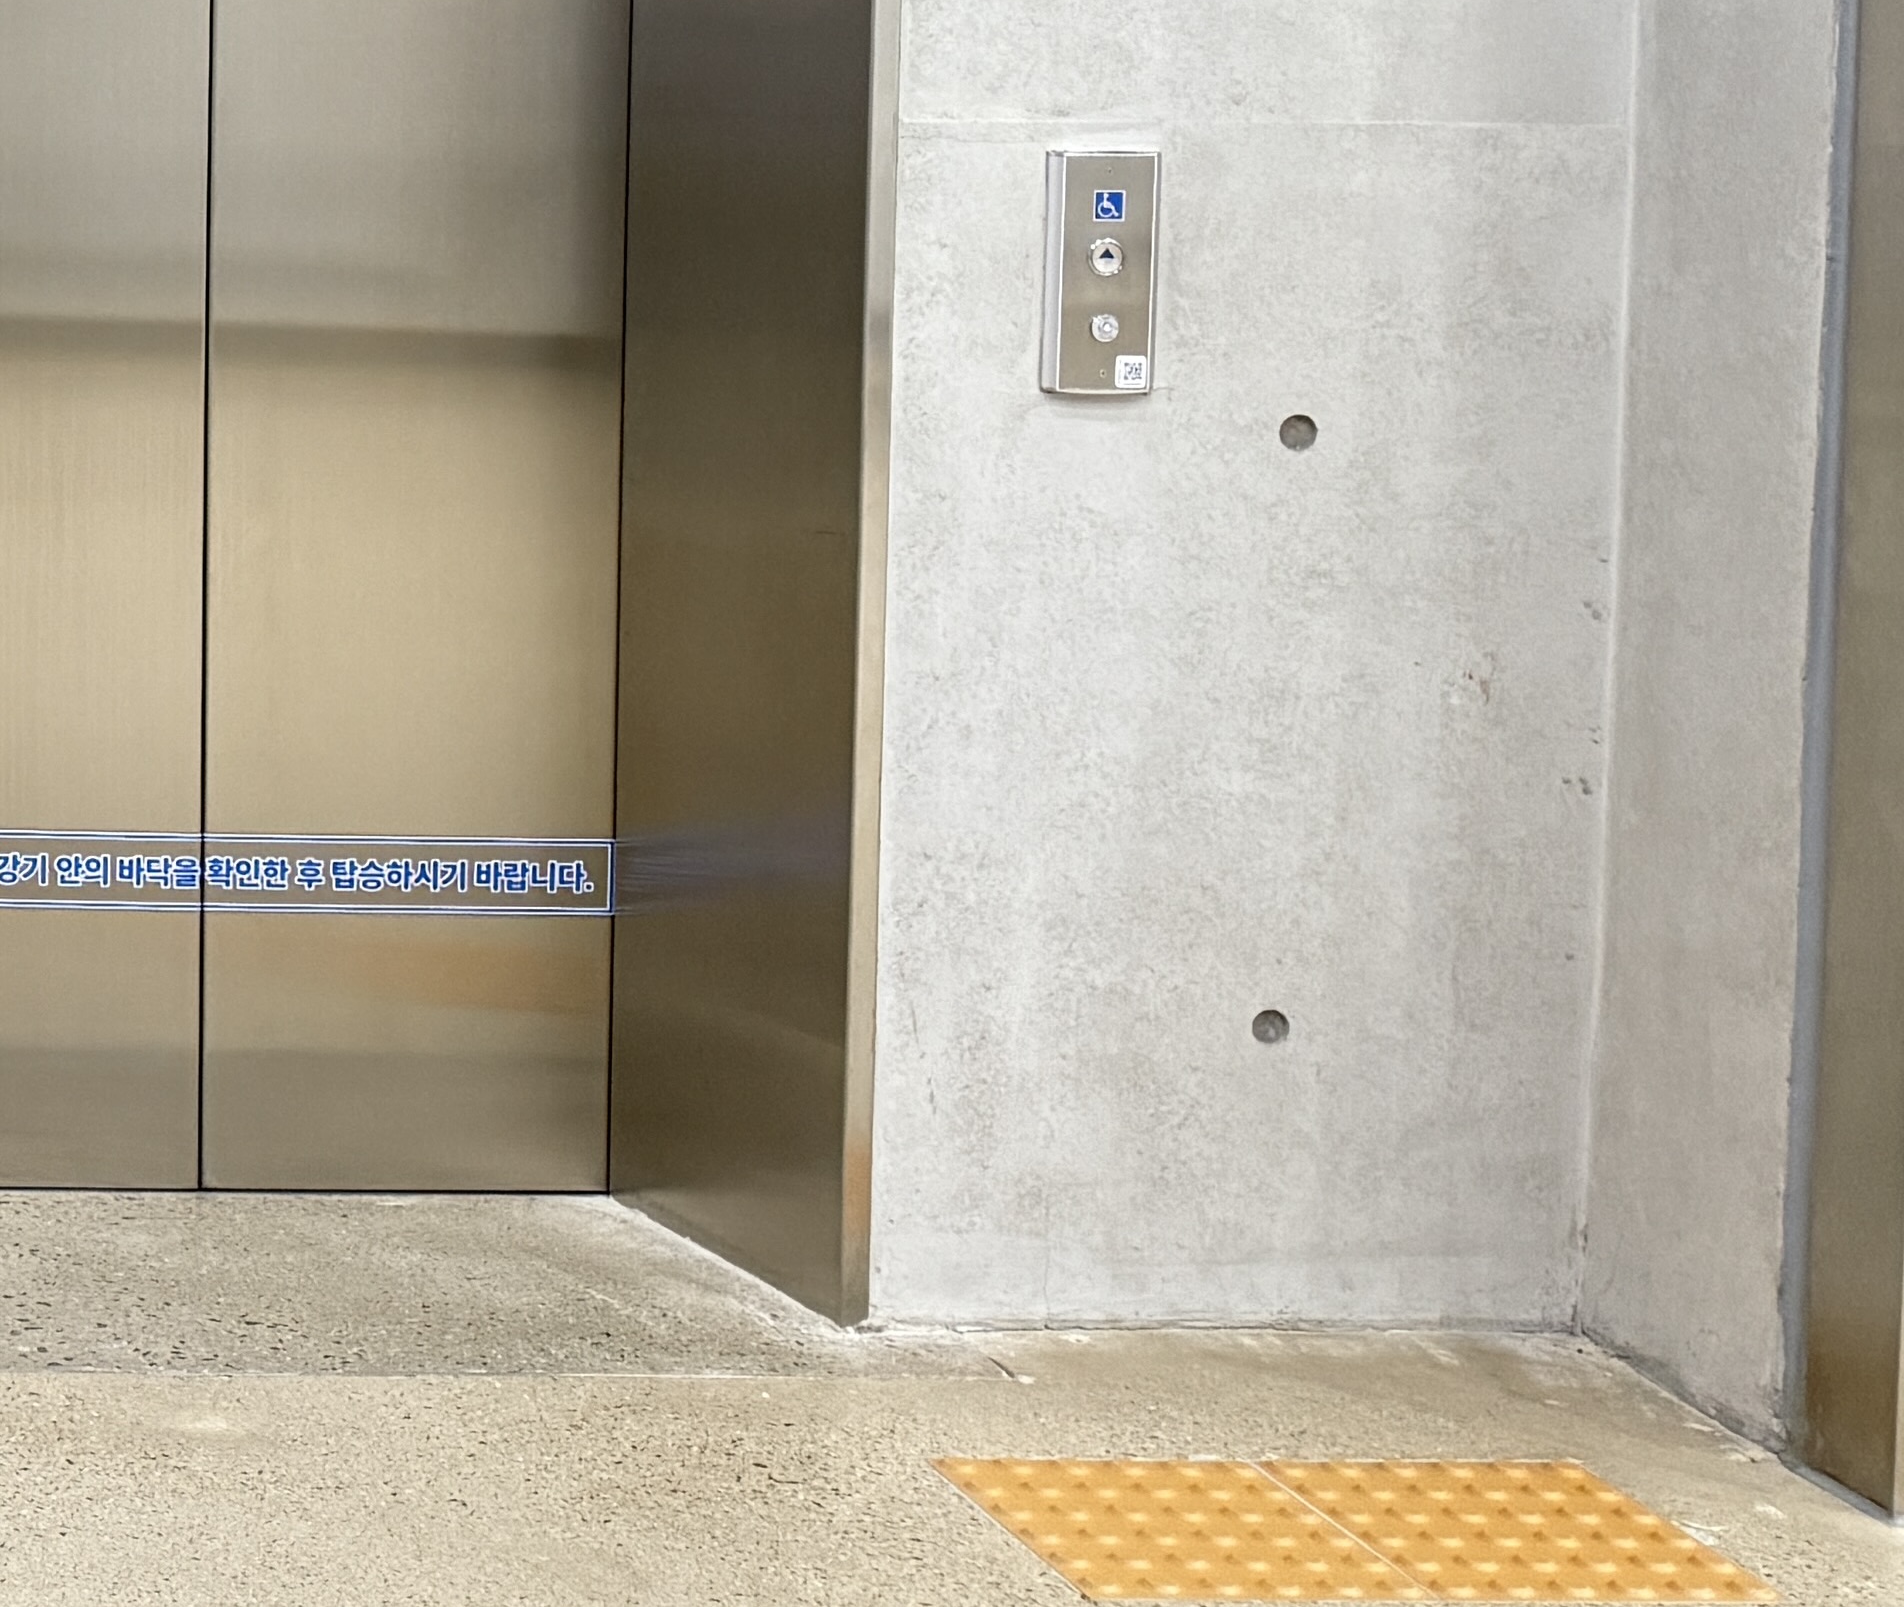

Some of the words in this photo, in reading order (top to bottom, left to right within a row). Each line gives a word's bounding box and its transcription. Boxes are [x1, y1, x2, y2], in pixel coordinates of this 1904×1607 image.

[54, 854, 111, 887] 안의
[116, 855, 201, 889] 바닥을
[206, 856, 289, 890] 확인한
[294, 858, 325, 891] 후
[330, 858, 468, 893] 탑승하시기
[474, 859, 595, 893] 바랍니다.
